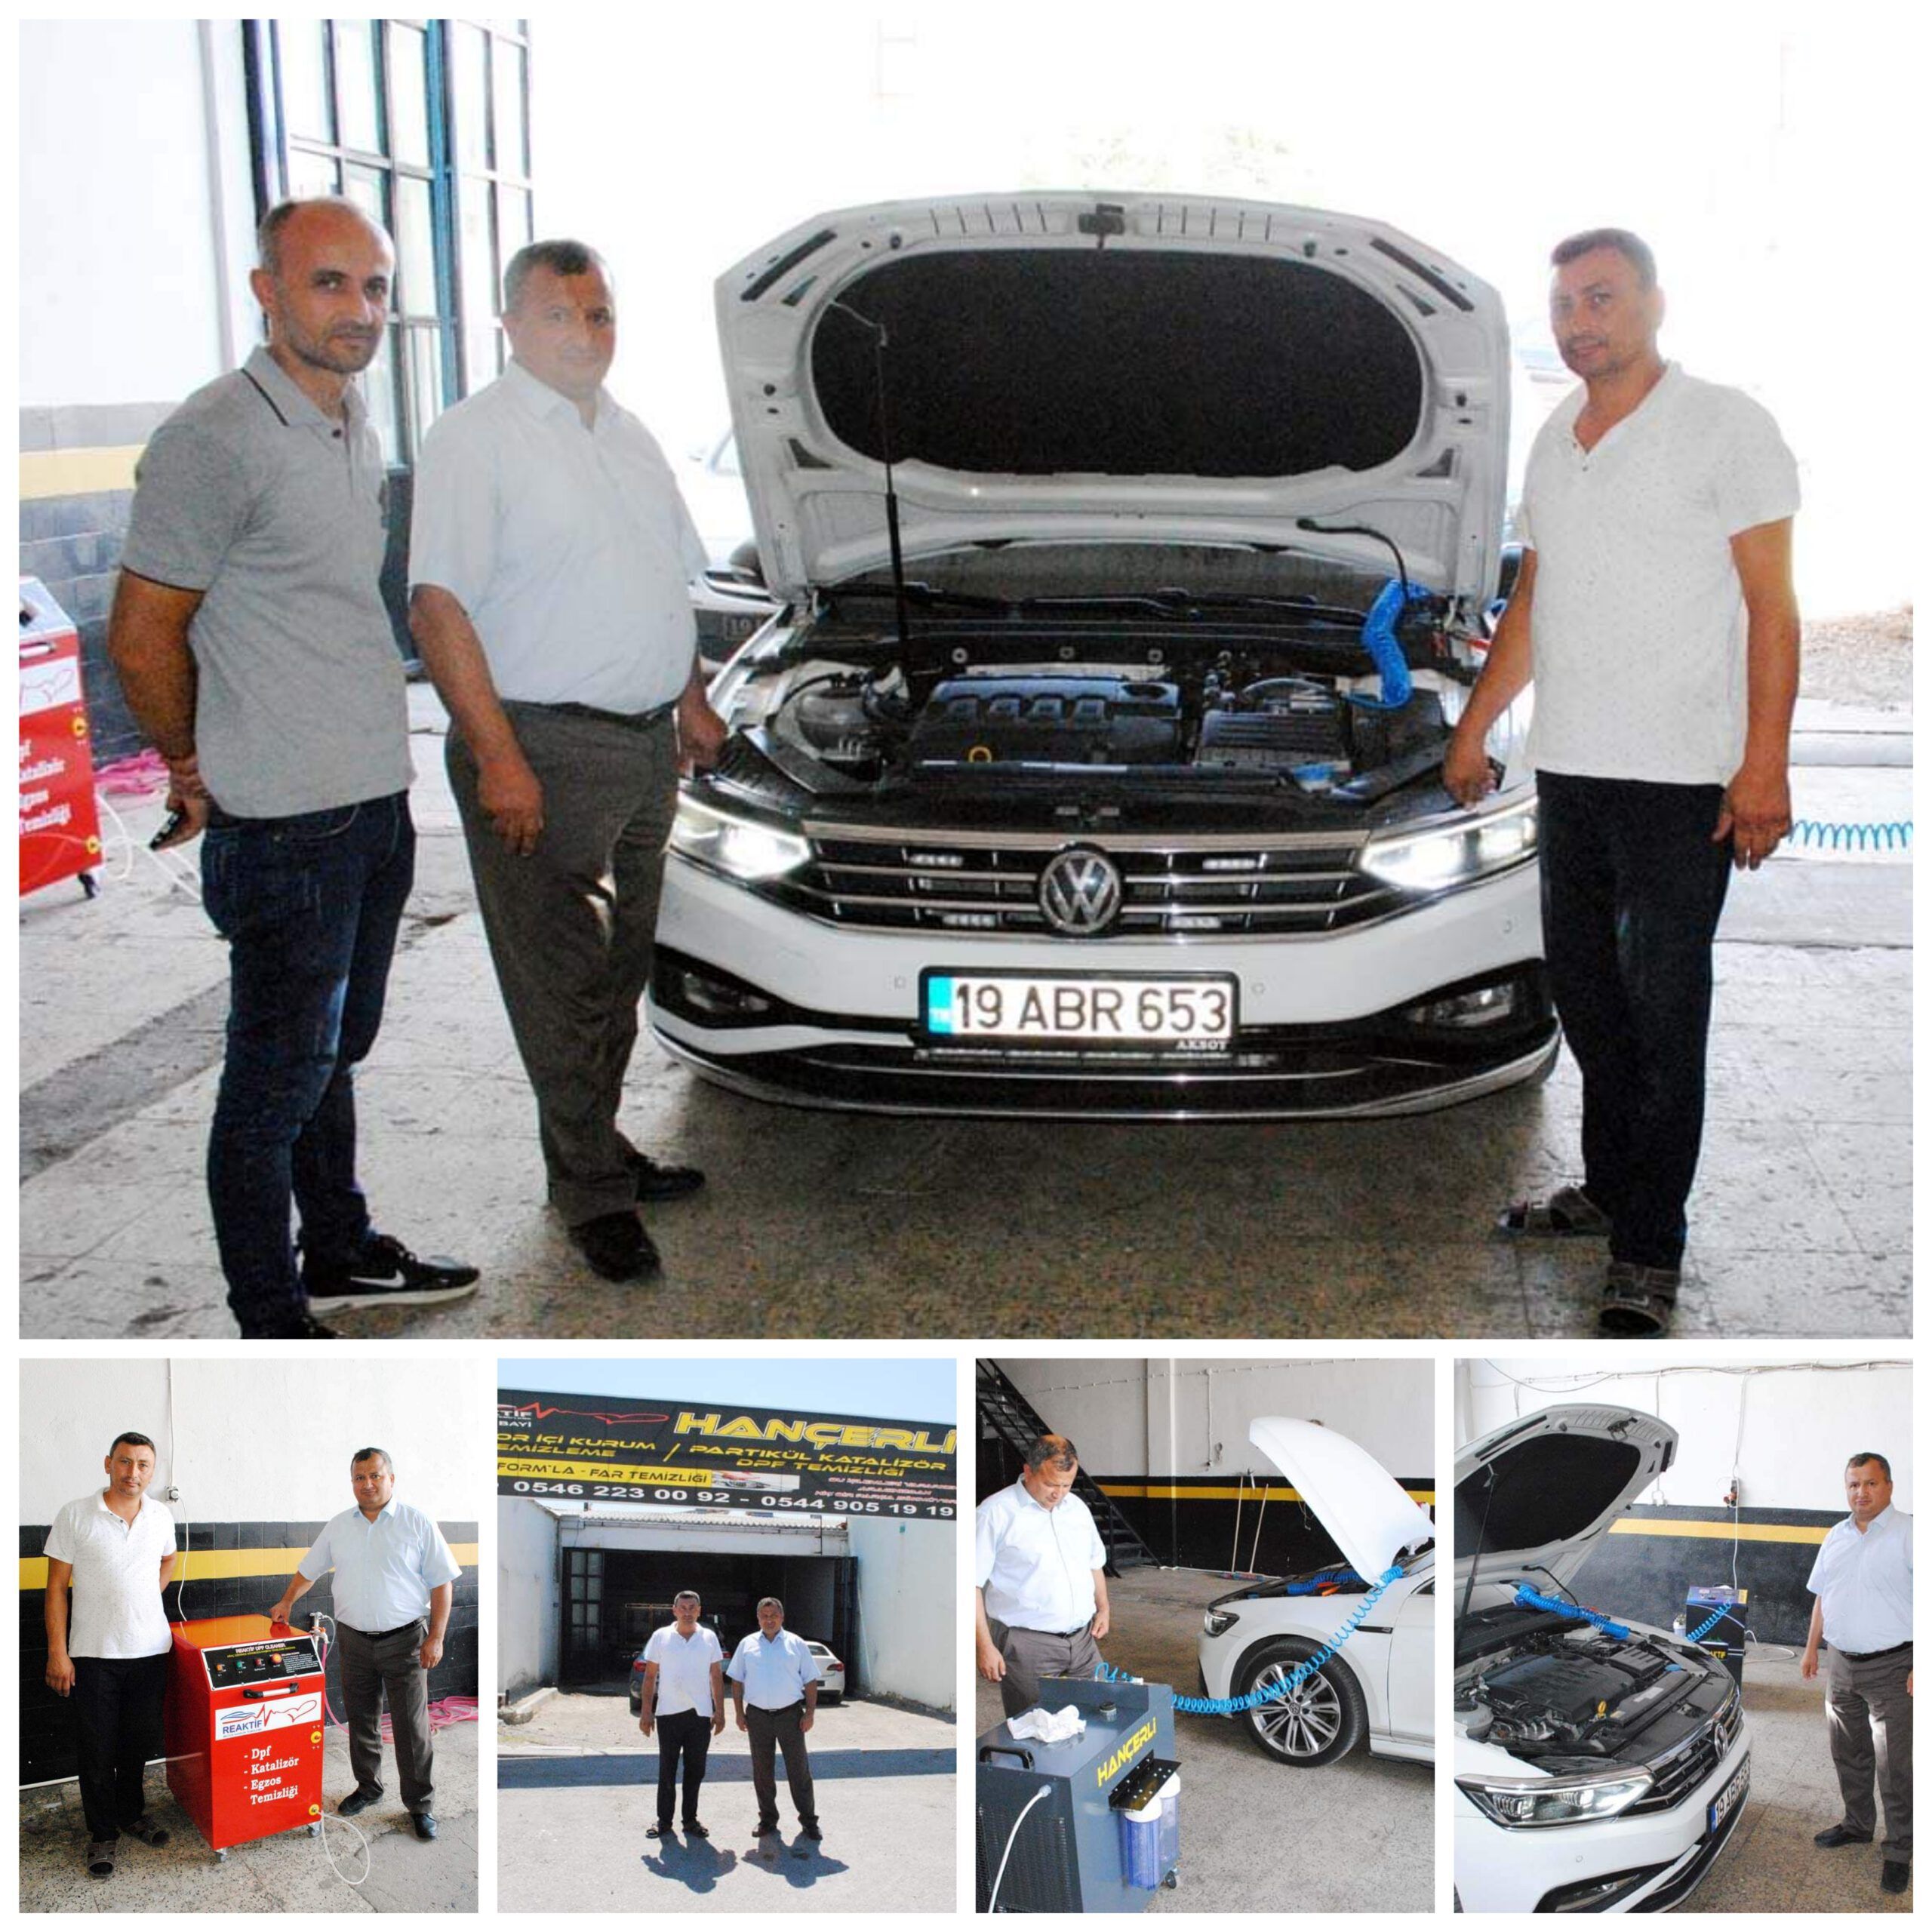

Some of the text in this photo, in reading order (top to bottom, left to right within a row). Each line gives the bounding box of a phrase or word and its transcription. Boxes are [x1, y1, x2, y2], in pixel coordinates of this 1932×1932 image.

[956, 984, 1226, 1032] 19 ABR 653
[535, 1434, 565, 1444] İÇİ
[569, 1437, 657, 1450] KURUM
[736, 1458, 905, 1477] DPF TEMİZLİĞİ
[819, 1454, 947, 1471] KATALİZÖR
[589, 1469, 624, 1479] FAR
[629, 1471, 707, 1484] TEMİZLİĞİ
[513, 1481, 584, 1495] 0546
[593, 1485, 645, 1498] 223
[654, 1488, 688, 1501] 00
[697, 1491, 731, 1503] 92
[761, 1495, 826, 1509] 0544
[833, 1500, 880, 1512] 905
[889, 1503, 918, 1514] 19
[926, 1506, 954, 1517] 19
[223, 1718, 262, 1734] REAKTİF
[251, 1745, 272, 1761] Dpf
[251, 1756, 300, 1775] Katalizör
[251, 1777, 281, 1791] Egzos
[250, 1785, 299, 1805] Temizliği
